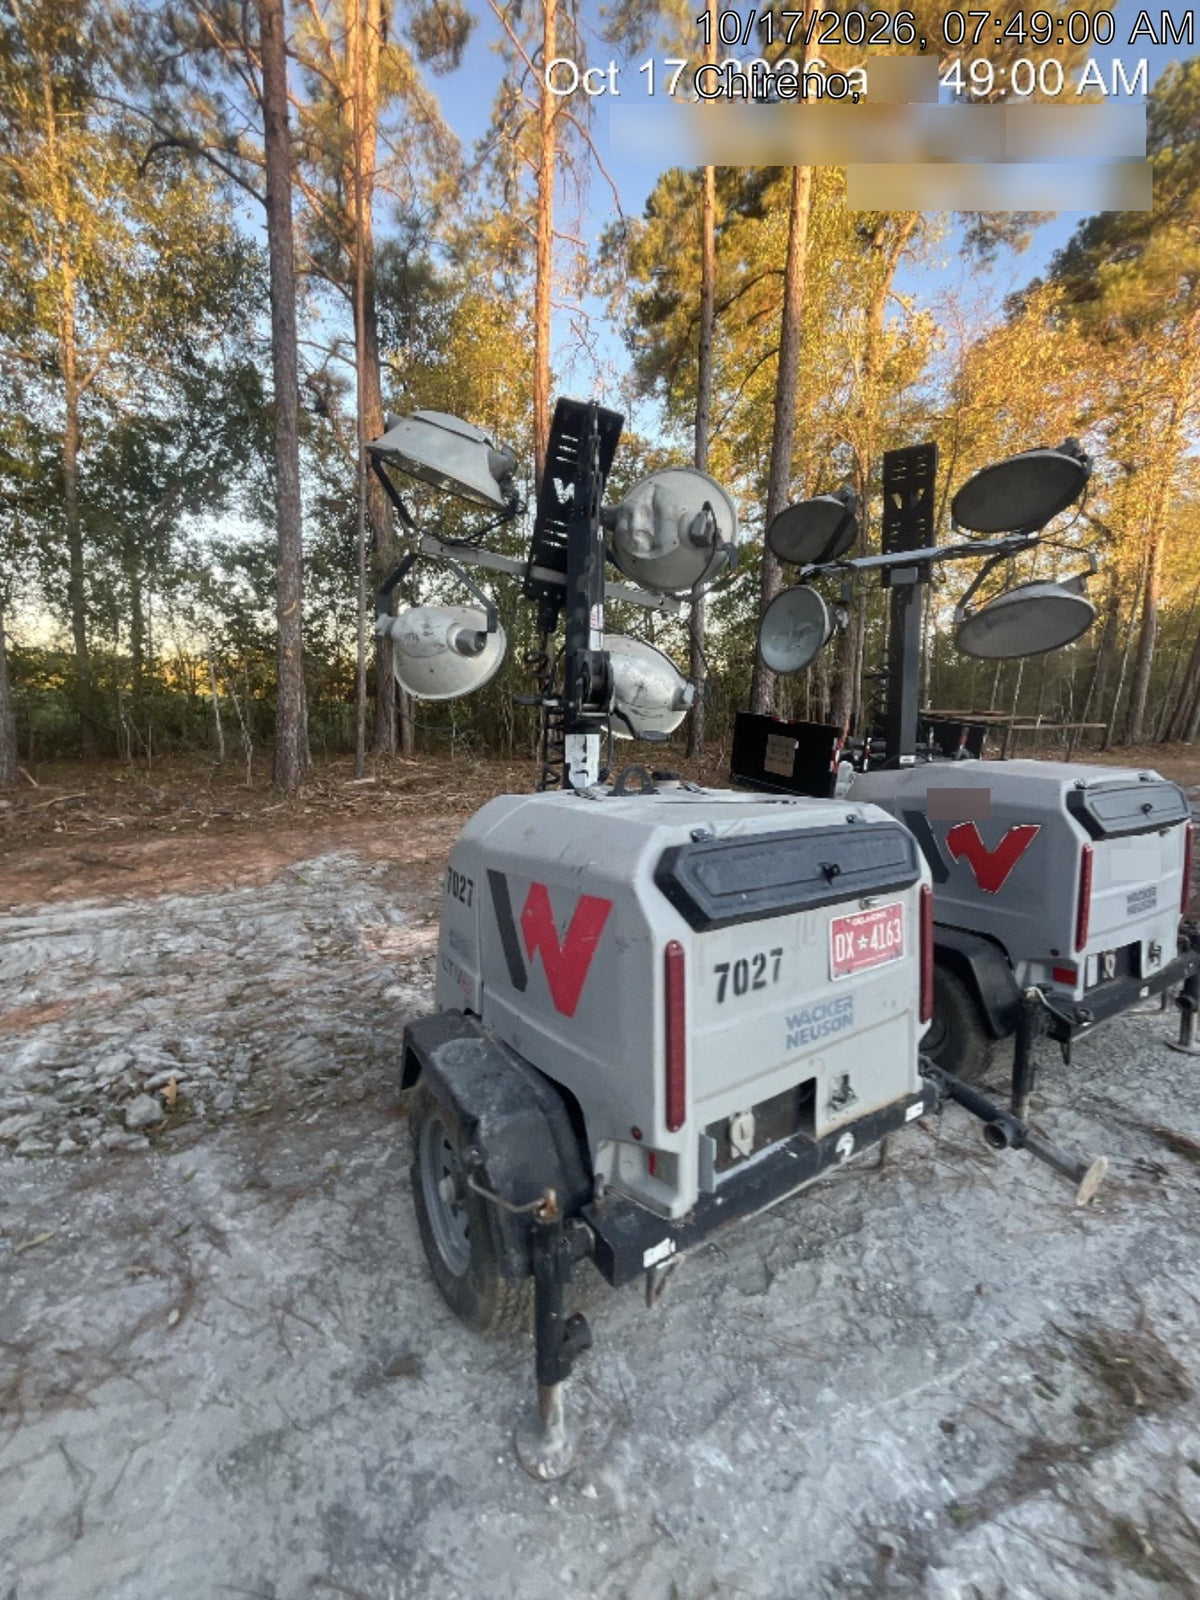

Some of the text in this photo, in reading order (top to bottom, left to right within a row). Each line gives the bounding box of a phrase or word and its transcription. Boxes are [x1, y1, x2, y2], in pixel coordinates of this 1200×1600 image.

[835, 931, 855, 962] DX
[869, 918, 902, 950] 4163
[714, 947, 783, 1003] 7027
[785, 995, 854, 1031] WACKER
[786, 1011, 854, 1050] NEUSON
